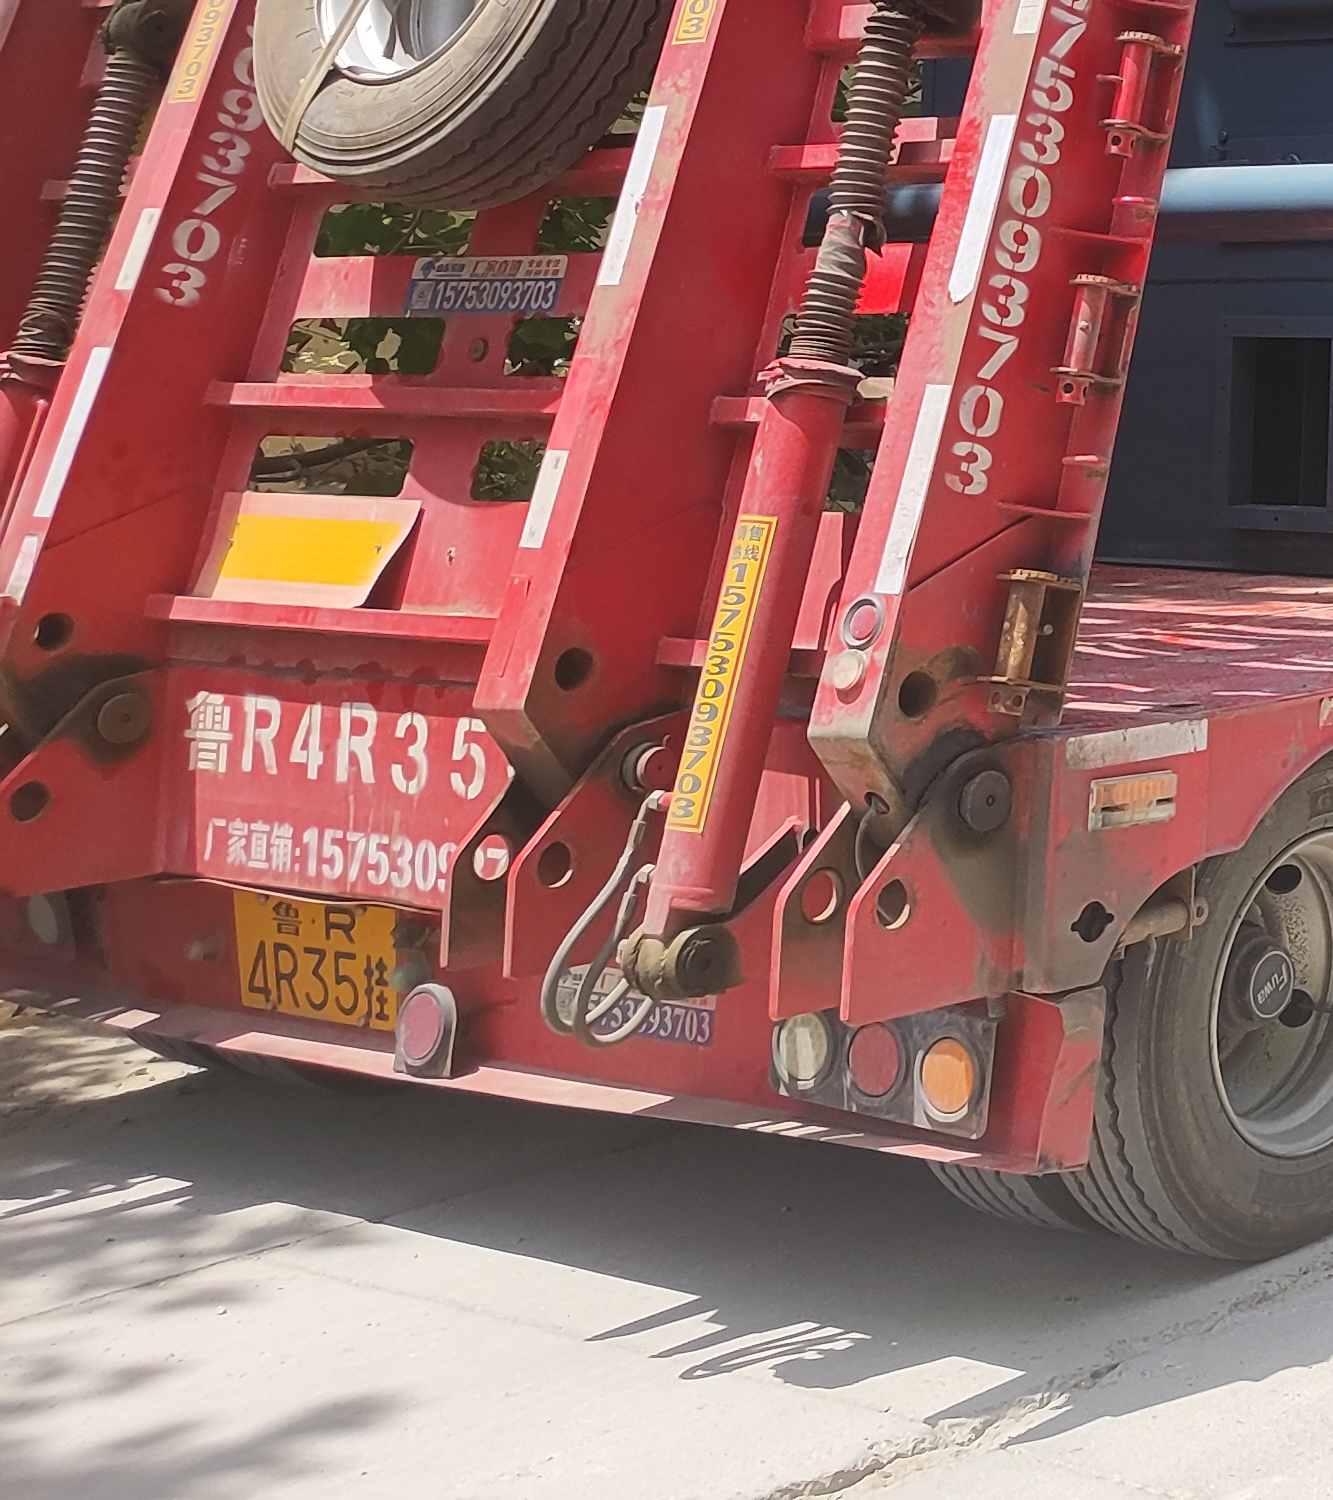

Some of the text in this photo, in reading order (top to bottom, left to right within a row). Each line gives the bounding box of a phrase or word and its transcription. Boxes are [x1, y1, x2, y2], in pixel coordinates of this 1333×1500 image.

[434, 280, 557, 311] 15753093703
[671, 562, 748, 819] 15753093703
[247, 939, 390, 1029] 4R35挂
